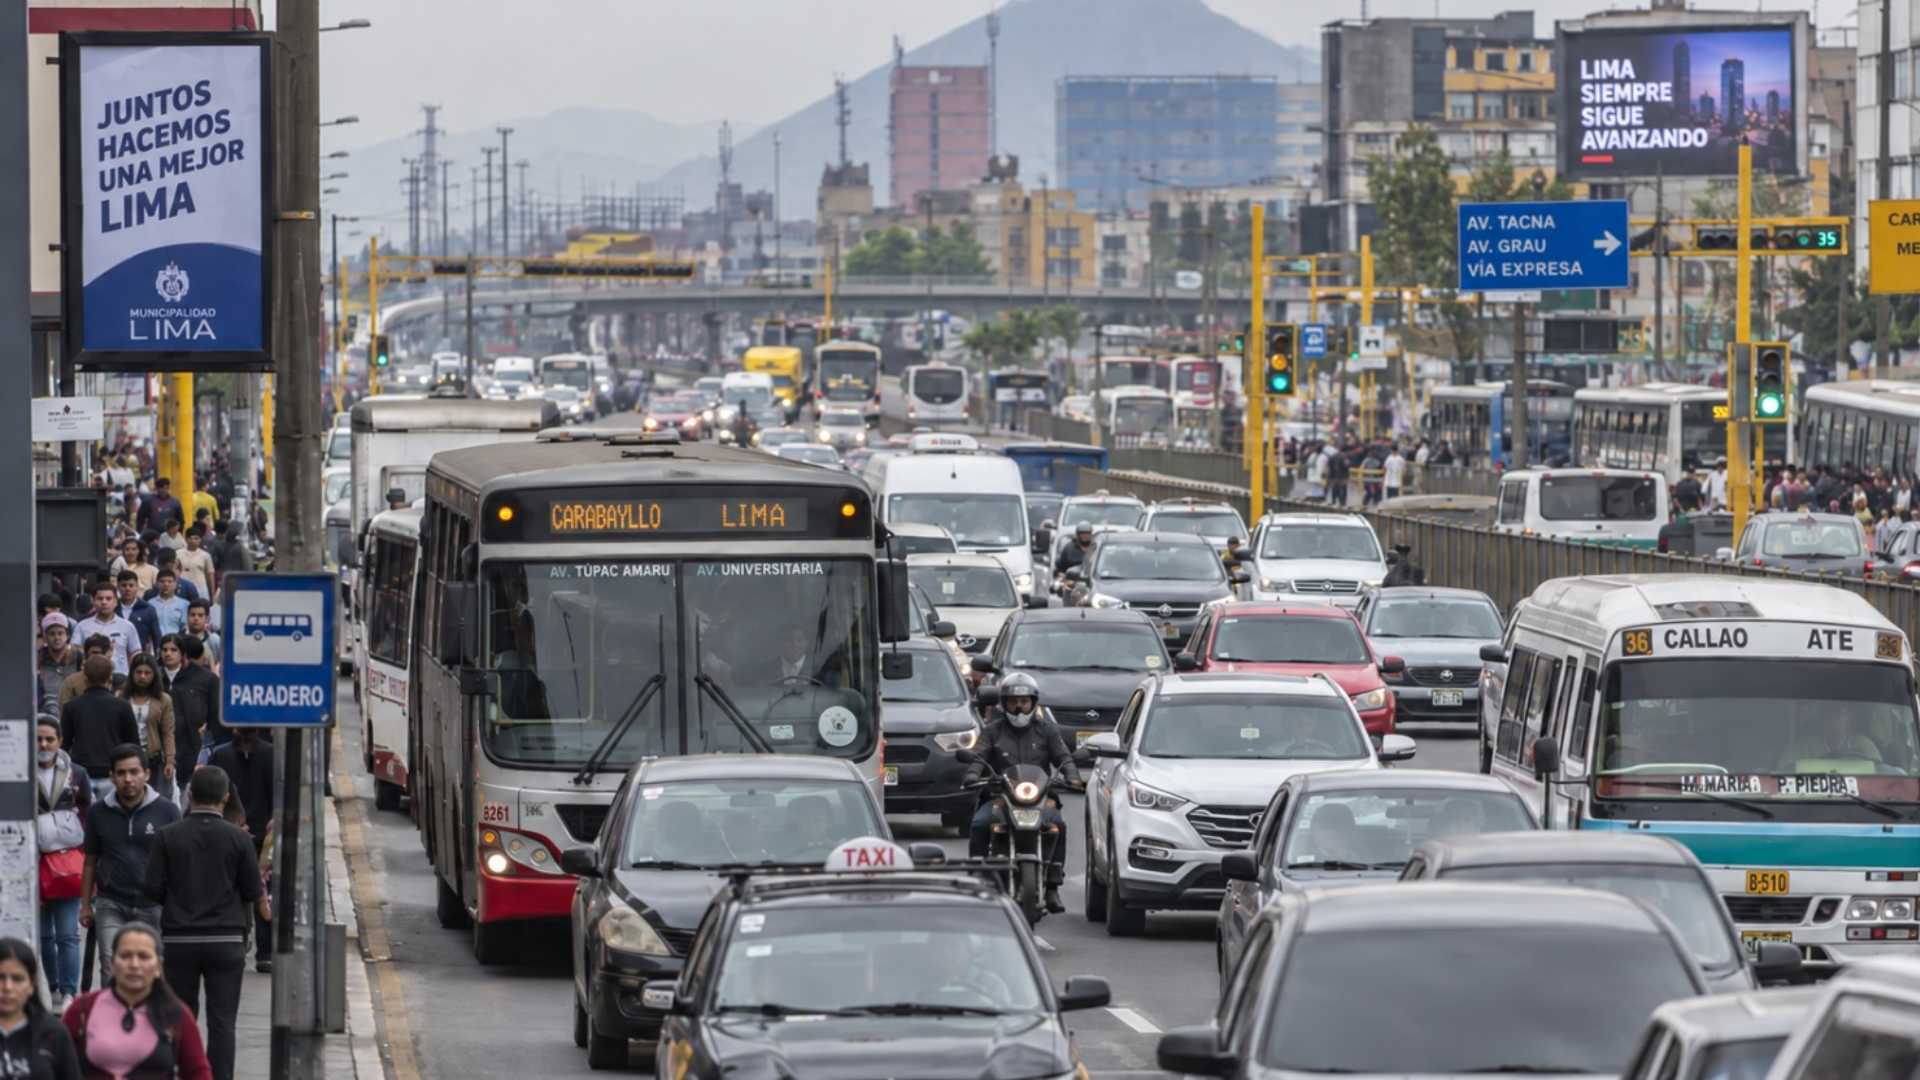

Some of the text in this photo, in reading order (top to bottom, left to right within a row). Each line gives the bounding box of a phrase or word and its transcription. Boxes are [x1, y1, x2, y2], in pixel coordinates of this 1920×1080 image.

[1580, 59, 1636, 80] LIMA
[1580, 82, 1673, 103] SIEMPRE
[97, 79, 212, 130] JUNTOS
[1581, 106, 1645, 127] SIGUE
[98, 109, 231, 162] HACEMOS
[1581, 128, 1709, 150] AVANZANDO
[99, 139, 245, 192] UNA MEJOR
[101, 181, 196, 234] LIMA
[1467, 214, 1556, 231] AV. TACNA
[1467, 239, 1547, 254] AV. GRAU
[1817, 231, 1837, 247] 35
[1467, 259, 1584, 277] VÍA EXPRESA
[129, 308, 217, 318] MUNICIPALIDAD
[130, 319, 217, 340] LIMA
[552, 503, 785, 529] CARABAYLLO LIMA
[550, 562, 671, 578] AV. TÚPAC AMARU
[696, 562, 824, 577] AV. UNIVERSITARIA
[1626, 630, 1649, 653] 36
[1663, 626, 1748, 650] CALLAO
[1807, 628, 1854, 651] ATE
[231, 684, 324, 707] PARADERO
[843, 847, 895, 867] TAXI
